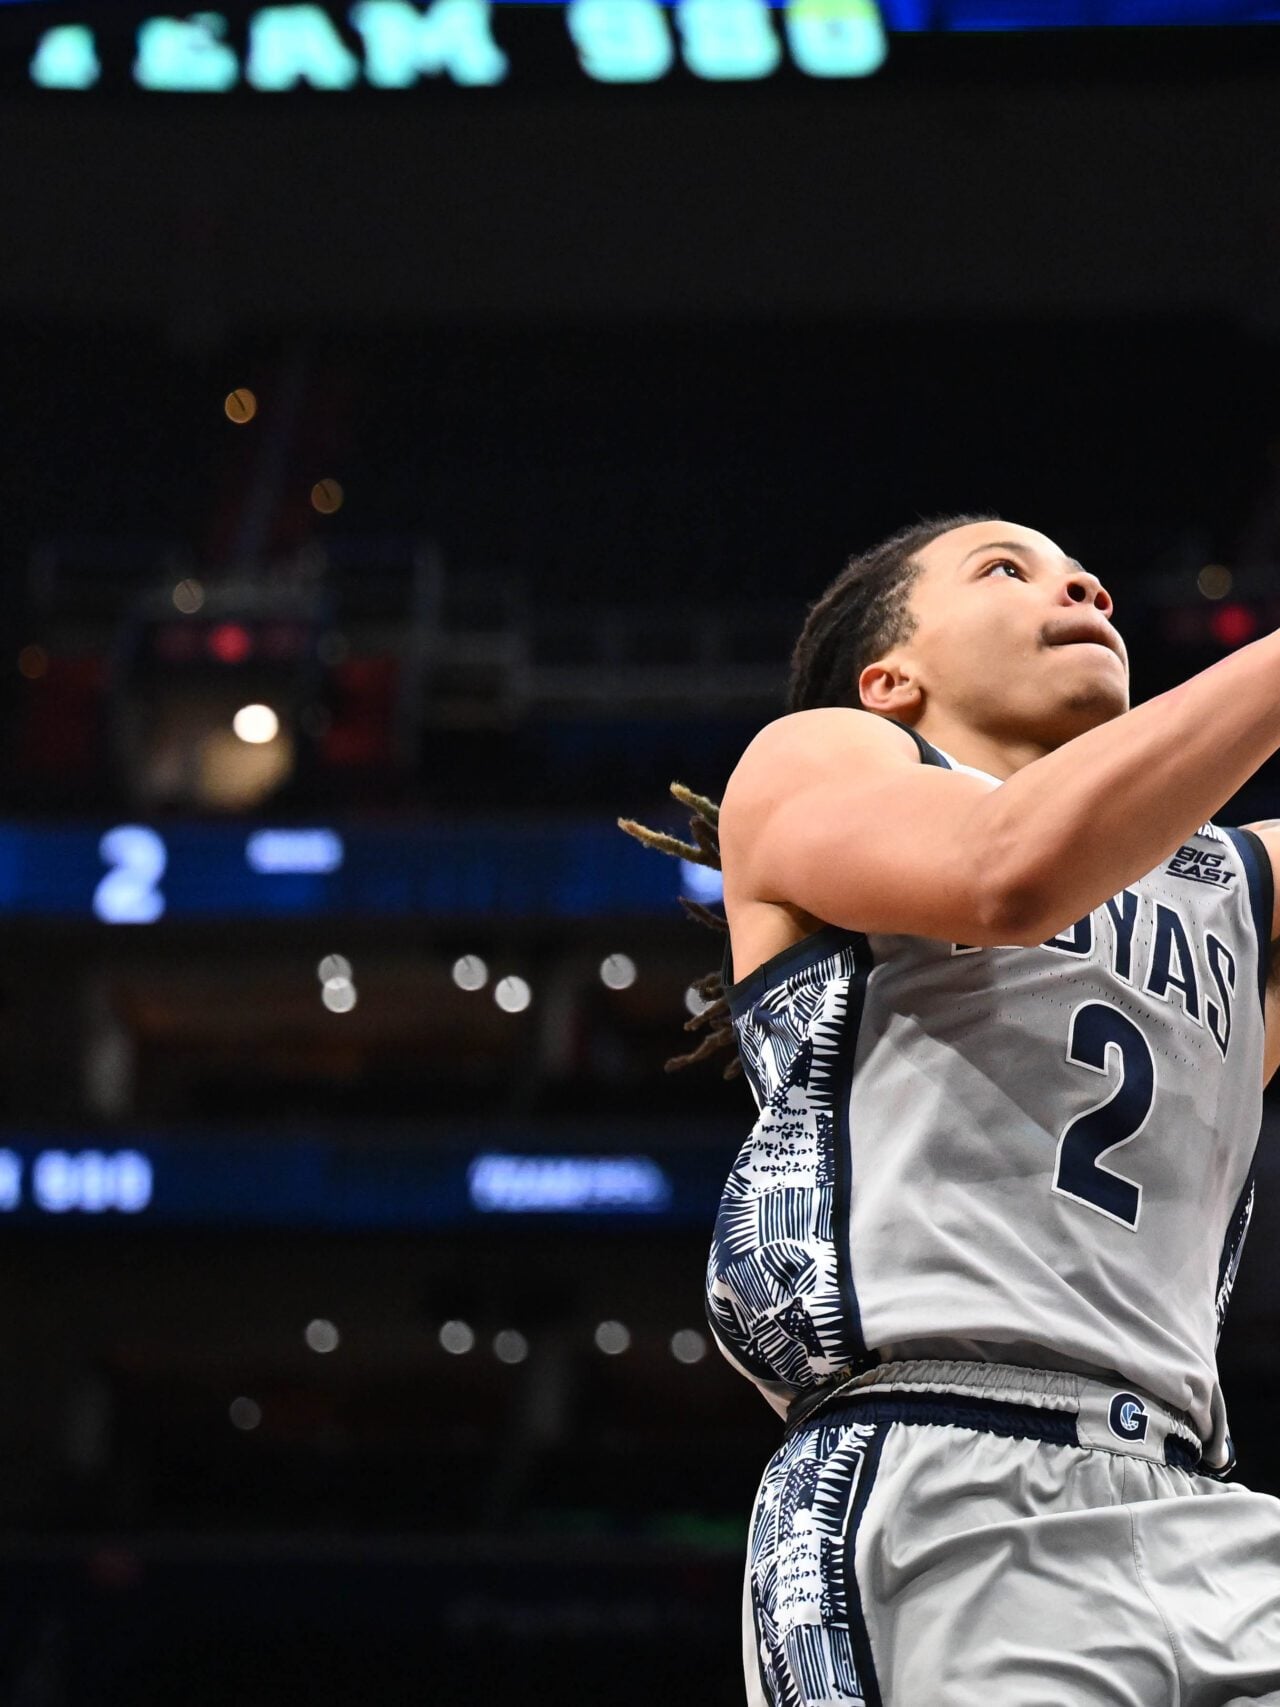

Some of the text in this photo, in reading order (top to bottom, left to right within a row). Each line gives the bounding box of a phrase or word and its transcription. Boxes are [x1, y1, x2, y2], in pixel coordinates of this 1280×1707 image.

[95, 824, 165, 924] 2
[1167, 858, 1236, 884] EAST
[1175, 845, 1226, 868] BIG
[1051, 1000, 1157, 1232] 2
[1108, 1391, 1150, 1443] G
